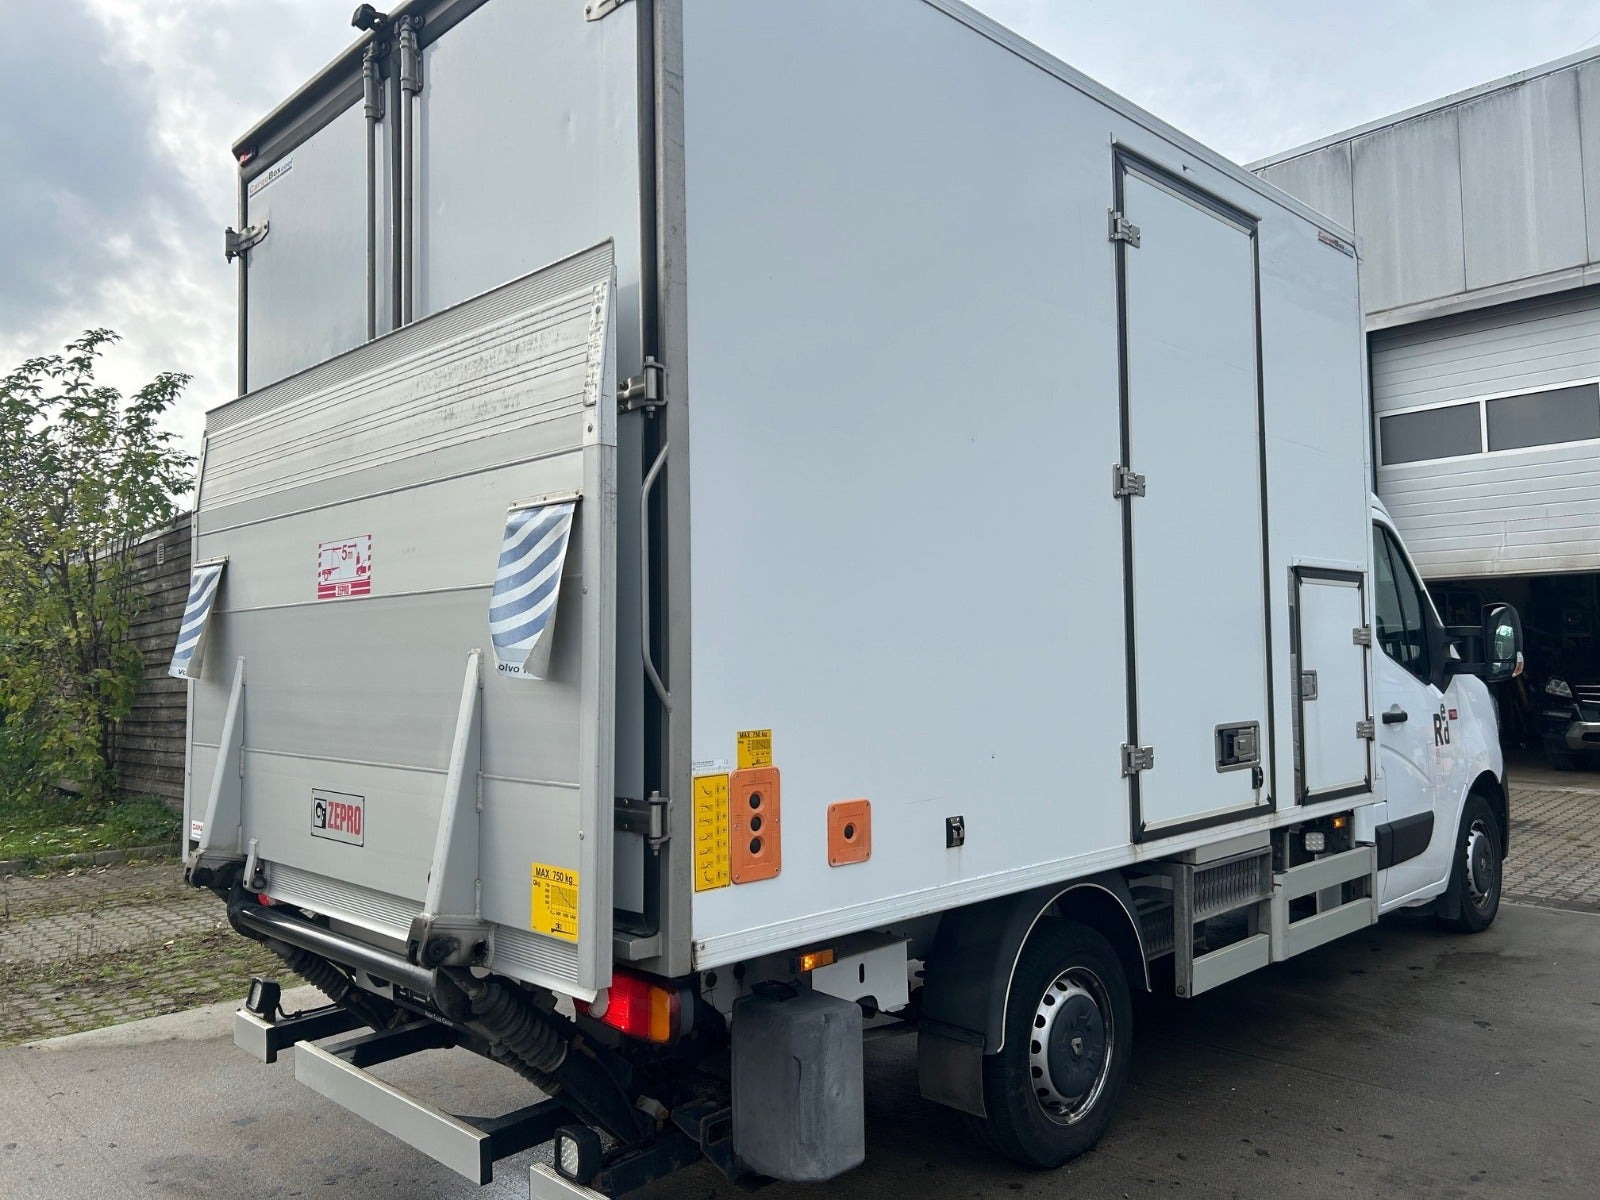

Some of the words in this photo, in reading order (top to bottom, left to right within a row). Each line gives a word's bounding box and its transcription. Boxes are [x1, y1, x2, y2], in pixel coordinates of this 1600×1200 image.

[739, 731, 750, 739] MAX
[327, 801, 361, 836] ZEPRO
[535, 866, 550, 879] MAX
[552, 870, 564, 882] 750
[564, 873, 573, 886] kg
